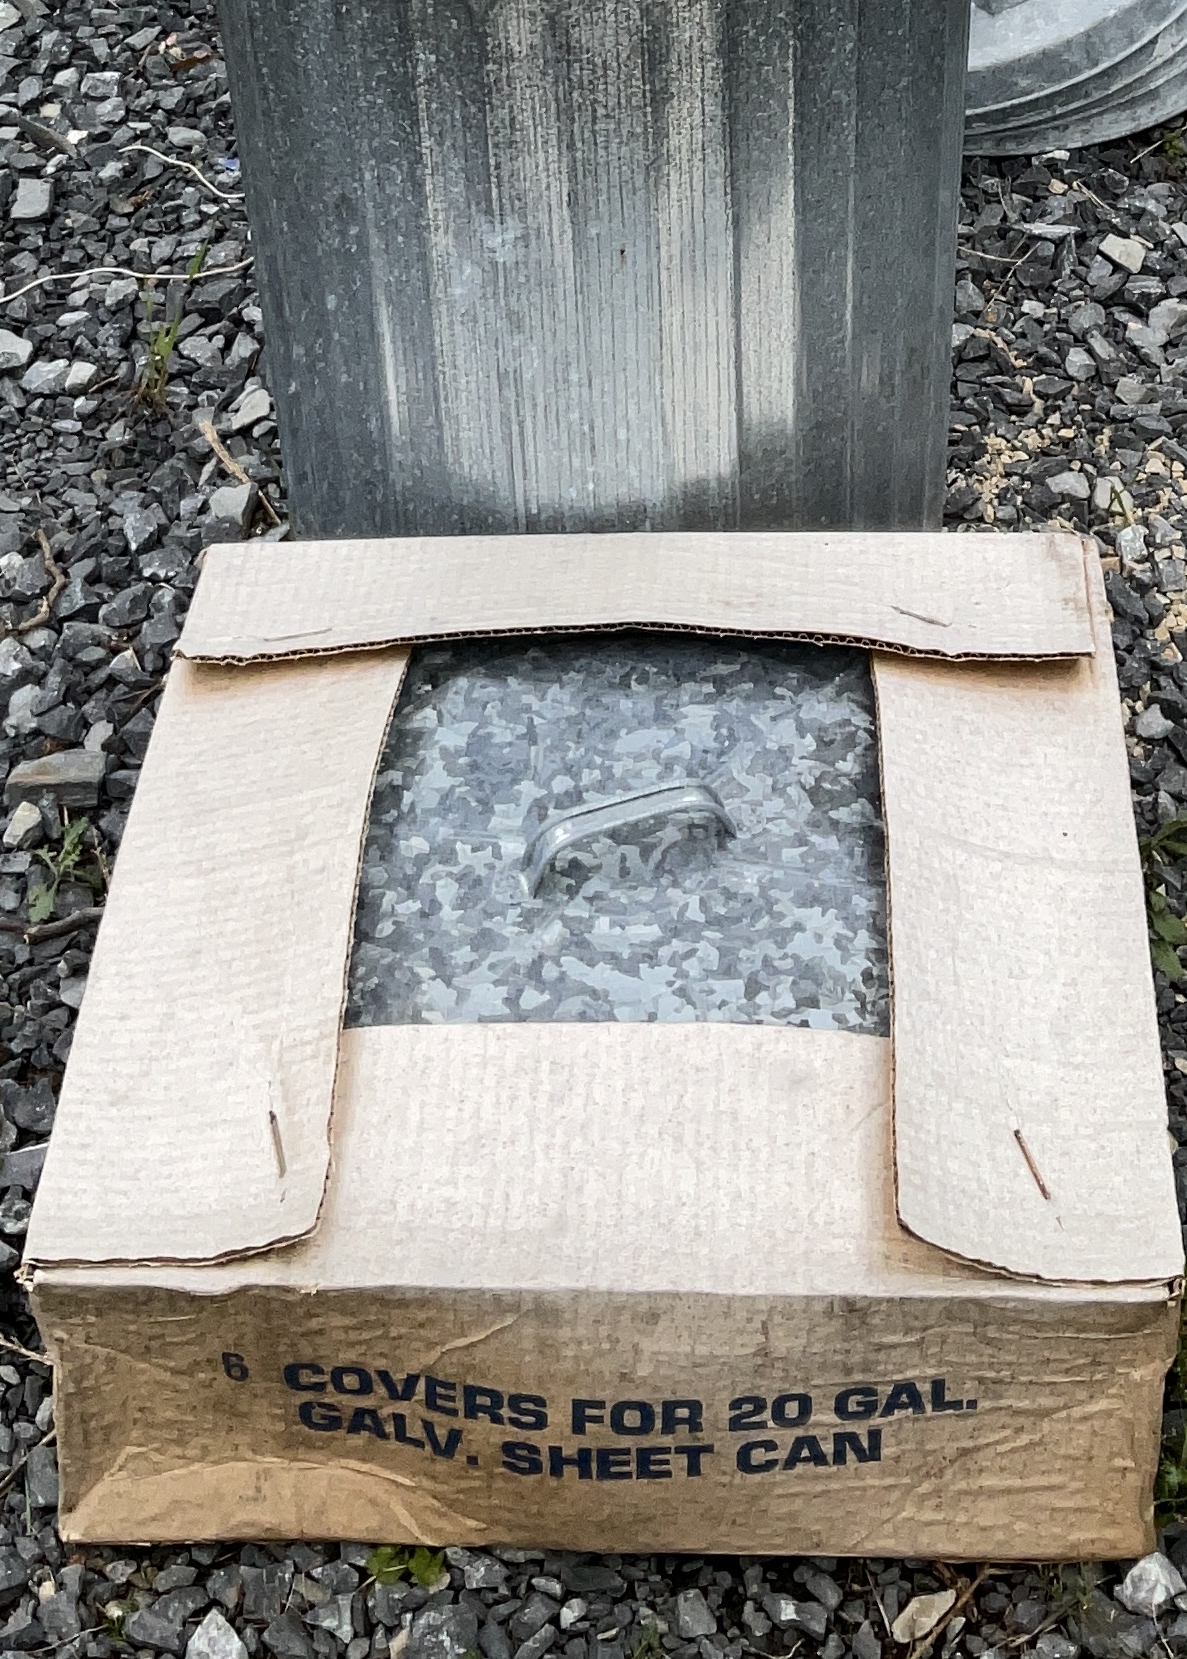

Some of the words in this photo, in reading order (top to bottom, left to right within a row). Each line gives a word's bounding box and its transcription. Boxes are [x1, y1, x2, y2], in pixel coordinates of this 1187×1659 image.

[221, 1351, 249, 1382] 6
[283, 1363, 549, 1431] COVERS
[571, 1398, 704, 1436] FOR
[728, 1392, 813, 1432] 20
[834, 1378, 978, 1422] GAL.
[299, 1401, 479, 1466] GALV.
[501, 1441, 715, 1481] SHEET
[736, 1428, 882, 1475] CAN
